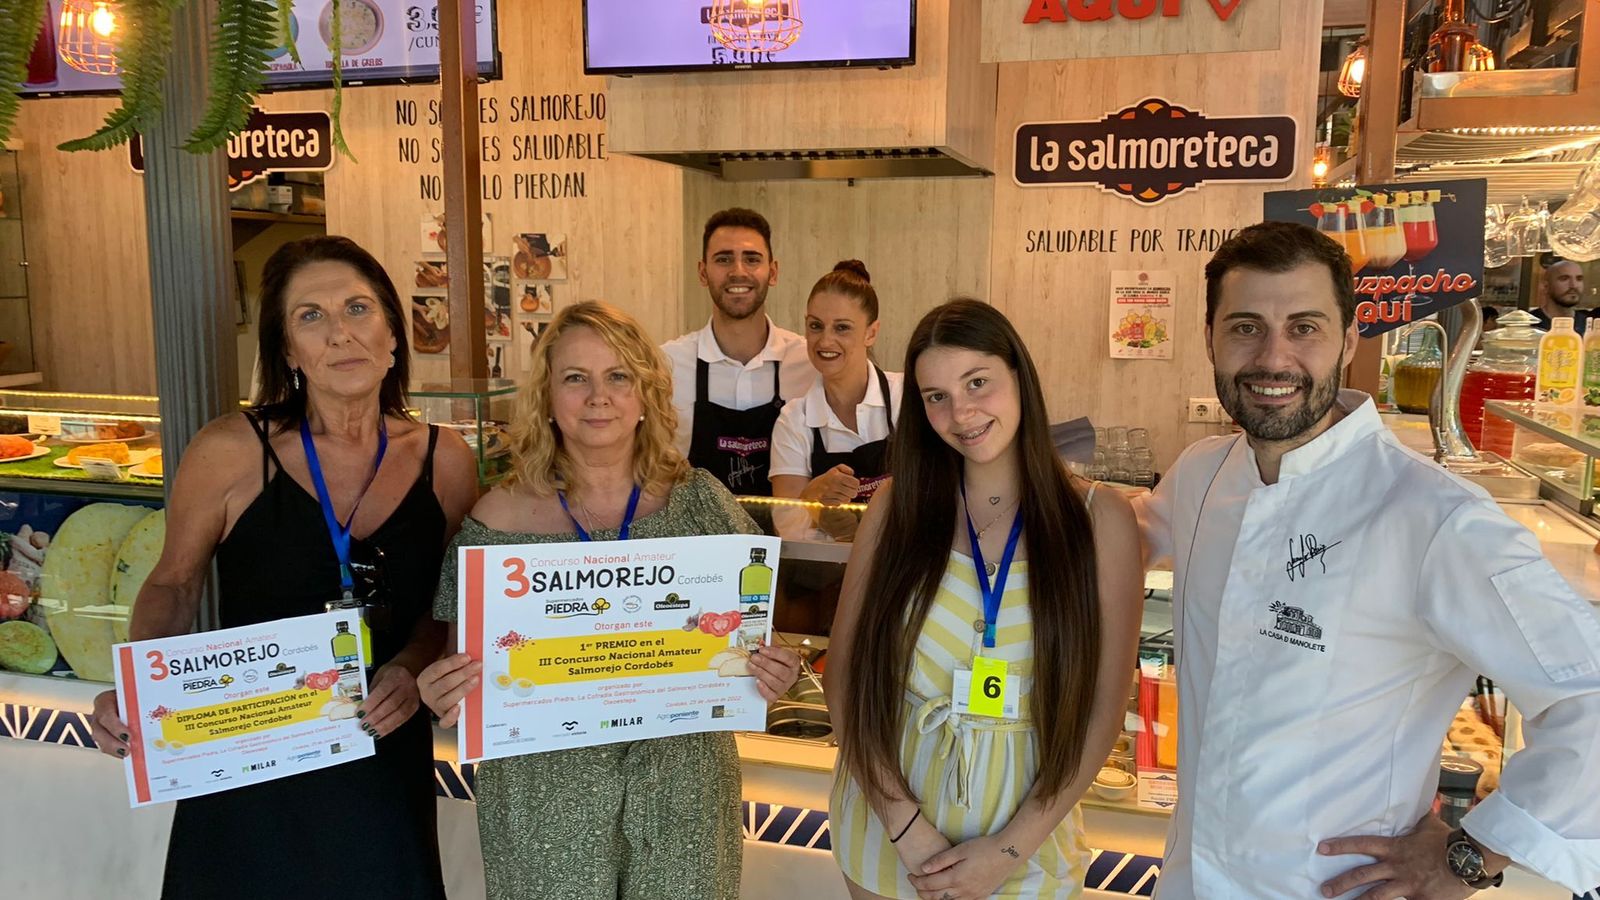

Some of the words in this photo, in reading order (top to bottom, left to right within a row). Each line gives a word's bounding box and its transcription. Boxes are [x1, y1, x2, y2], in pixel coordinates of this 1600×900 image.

[396, 99, 417, 126] NO
[480, 97, 498, 124] ES
[399, 137, 420, 163] NO
[482, 136, 500, 161] ES
[512, 133, 609, 161] SALUDABLE,
[1029, 136, 1059, 171] la
[1068, 131, 1279, 171] salmoreteca
[420, 174, 442, 200] NO
[483, 174, 502, 200] LO
[514, 172, 588, 199] PIERDAN.
[1026, 229, 1118, 252] SALUDABLE
[1130, 229, 1164, 252] POR
[530, 557, 580, 568] Concurso
[583, 554, 630, 565] Nacional
[633, 552, 676, 561] Amateur
[502, 557, 530, 598] 3
[532, 565, 675, 593] SALMOREJO
[678, 574, 723, 585] Cordobés
[595, 622, 630, 632] Otorgan
[206, 639, 242, 651] Nacional
[596, 640, 637, 650] PREMIO
[655, 638, 664, 646] el
[1259, 628, 1267, 636] LA
[1268, 631, 1283, 640] CASA
[1289, 637, 1325, 652] MANOLETE
[146, 650, 169, 681] 3
[169, 643, 279, 676] SALMOREJO
[539, 658, 552, 666] III
[554, 654, 606, 665] Concurso
[609, 650, 656, 661] Nacional
[658, 647, 702, 657] Amateur
[568, 662, 621, 676] Salmorejo
[624, 660, 673, 671] Cordobés
[224, 689, 253, 700] Otorgan
[983, 676, 1001, 699] 6
[177, 710, 217, 723] DIPLOMA
[219, 708, 230, 716] DE
[232, 693, 297, 712] PARTICIPACIÓN
[185, 723, 196, 731] III
[197, 715, 238, 729] Concurso
[240, 708, 277, 720] Nacional
[279, 701, 312, 713] Amateur
[209, 723, 252, 735] Salmorejo
[254, 713, 292, 726] Cordobés
[610, 717, 643, 728] MILAR
[250, 760, 277, 771] MILAR
